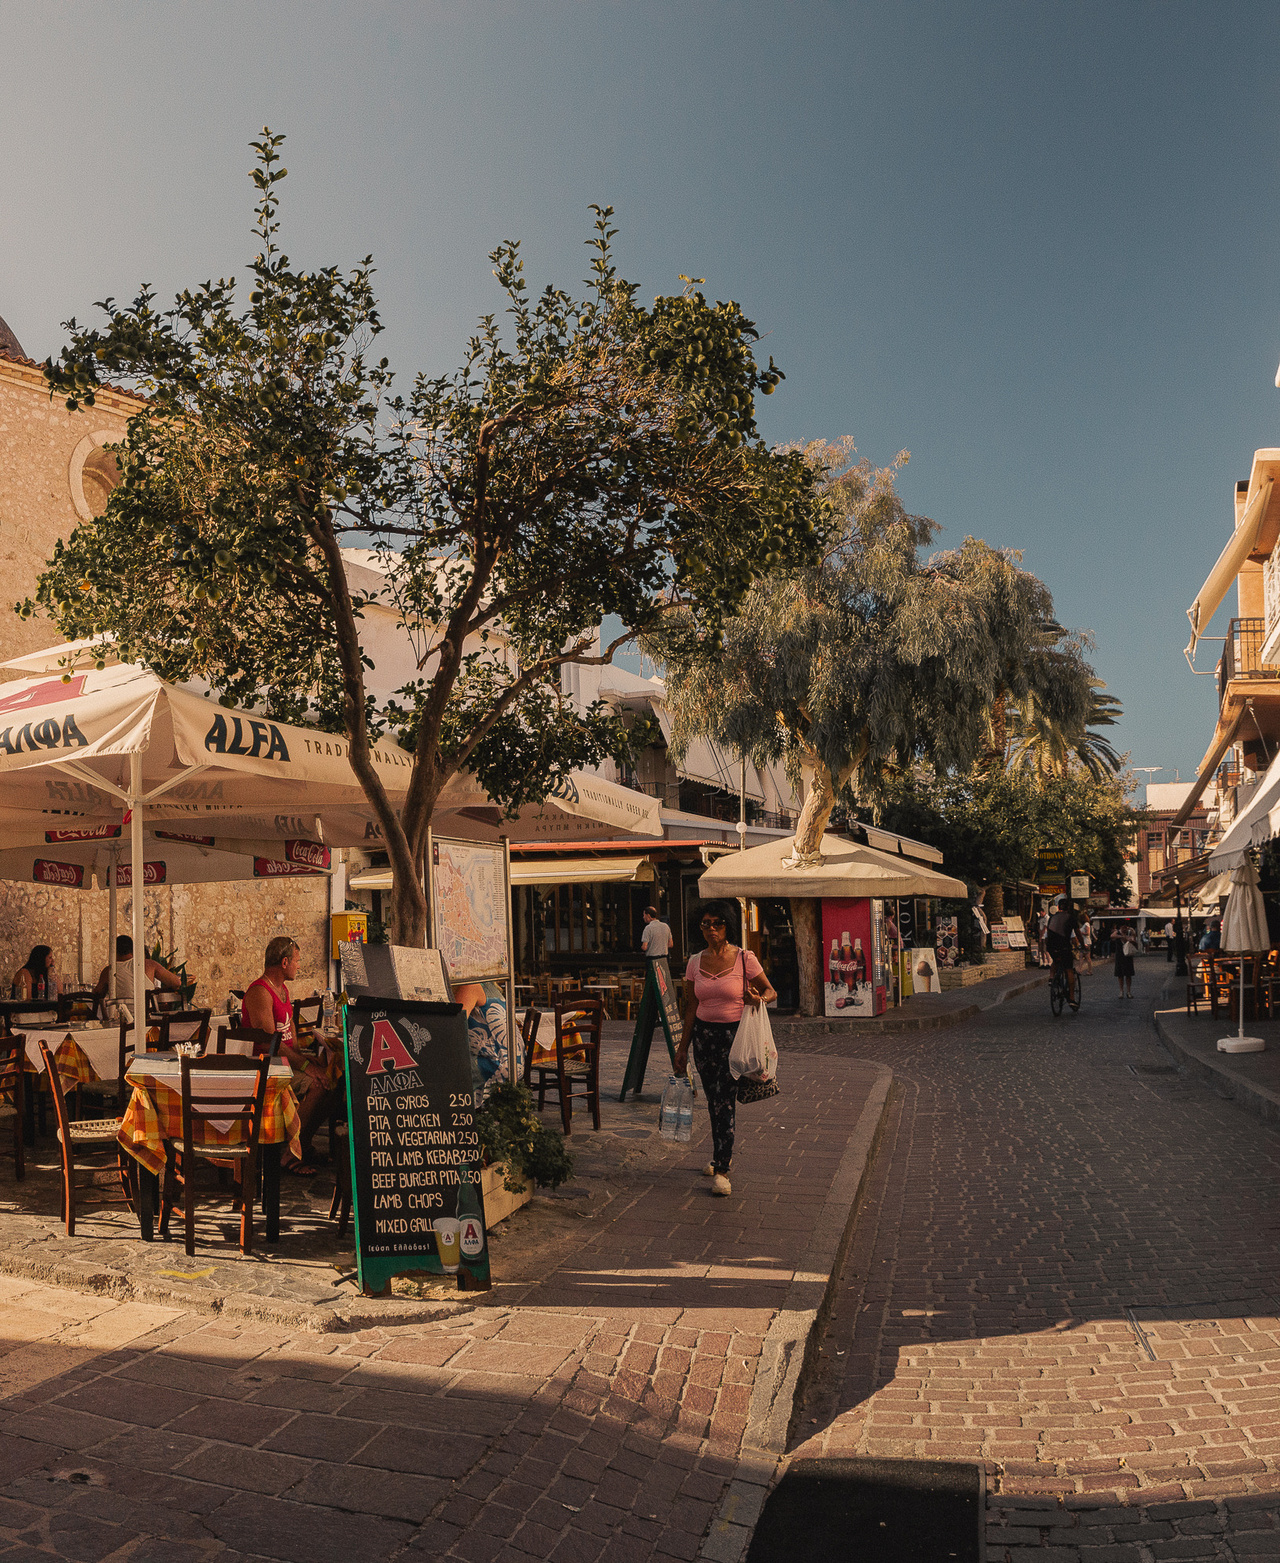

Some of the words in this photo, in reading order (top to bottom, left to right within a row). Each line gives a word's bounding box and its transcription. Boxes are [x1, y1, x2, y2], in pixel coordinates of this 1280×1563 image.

[205, 713, 291, 762] ALFA
[305, 739, 415, 768] TRADINALLY
[370, 1010, 387, 1020] 1961
[370, 1070, 424, 1096] ΑΛΦΑ
[367, 1096, 391, 1111] PITA
[396, 1094, 430, 1110] GYROS
[368, 1115, 391, 1130] PITA
[396, 1113, 441, 1128] CHICKEN
[370, 1131, 393, 1147] PITA
[397, 1131, 456, 1146] VEGETARIAN
[371, 1151, 394, 1167] PITA
[396, 1150, 424, 1166] LAMB
[426, 1149, 461, 1165] KEBAB
[372, 1173, 397, 1189] BEEF
[399, 1170, 439, 1189] BURGER
[439, 1170, 462, 1186] PITA
[374, 1193, 403, 1209] LAMB
[408, 1192, 444, 1209] CHOPS
[375, 1218, 408, 1234] MIXED
[410, 1217, 438, 1233] GRILL
